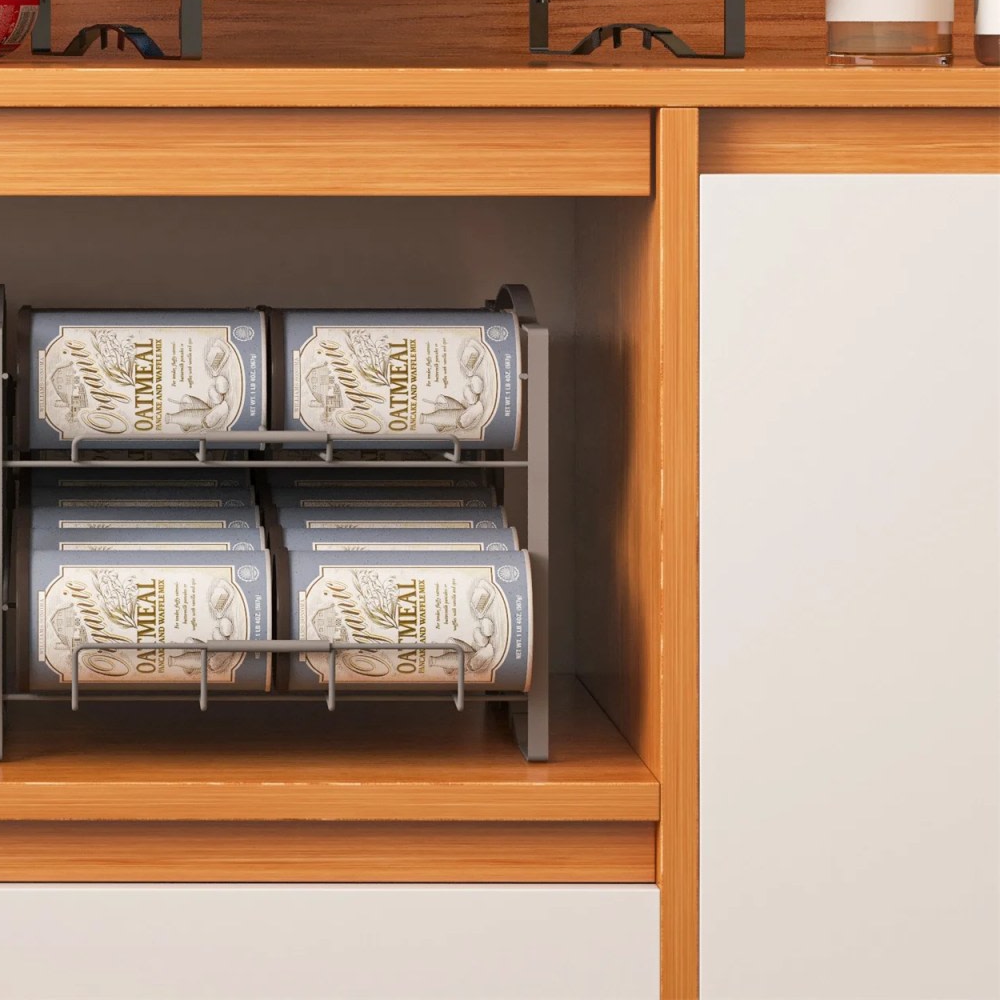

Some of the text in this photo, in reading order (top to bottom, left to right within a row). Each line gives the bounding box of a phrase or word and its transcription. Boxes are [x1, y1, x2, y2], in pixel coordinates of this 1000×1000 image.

[63, 341, 130, 434] Organic
[134, 339, 153, 431] OATMEAL
[317, 341, 385, 434] Organic
[388, 339, 408, 431] OATMEAL
[418, 595, 426, 624] WAFFLE
[418, 626, 426, 643] AND
